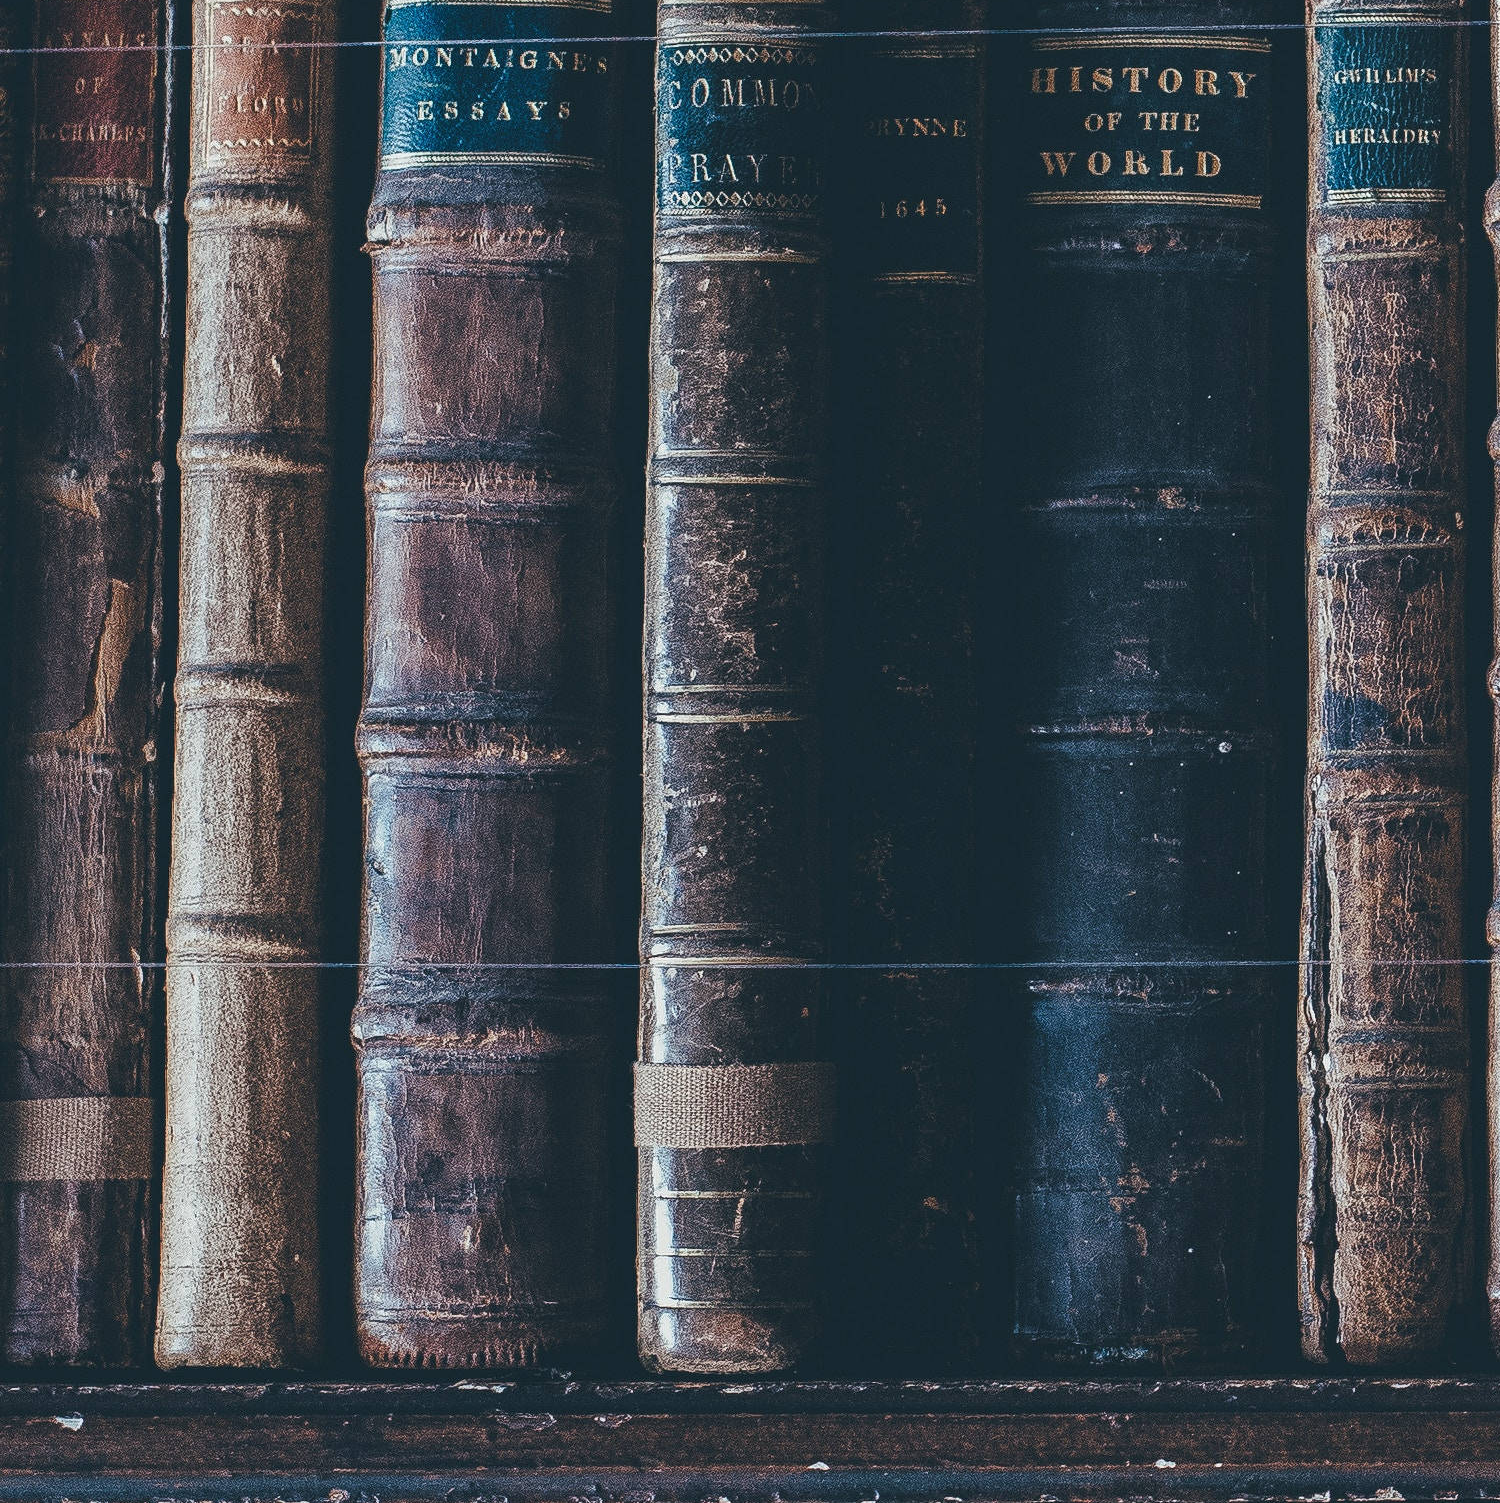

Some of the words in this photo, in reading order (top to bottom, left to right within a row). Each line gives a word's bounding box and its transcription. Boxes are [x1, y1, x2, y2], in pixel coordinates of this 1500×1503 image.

[389, 45, 609, 75] MONTAIGNE'S
[74, 77, 104, 95] OF
[667, 77, 820, 111] COMMON
[1030, 66, 1259, 99] HISTORY
[416, 99, 574, 123] ESSAYS
[1084, 111, 1123, 131] OF
[1138, 111, 1201, 131] THE
[1333, 128, 1442, 146] HERALDRY
[1040, 150, 1223, 178] WORLD
[880, 196, 949, 220] 1645
